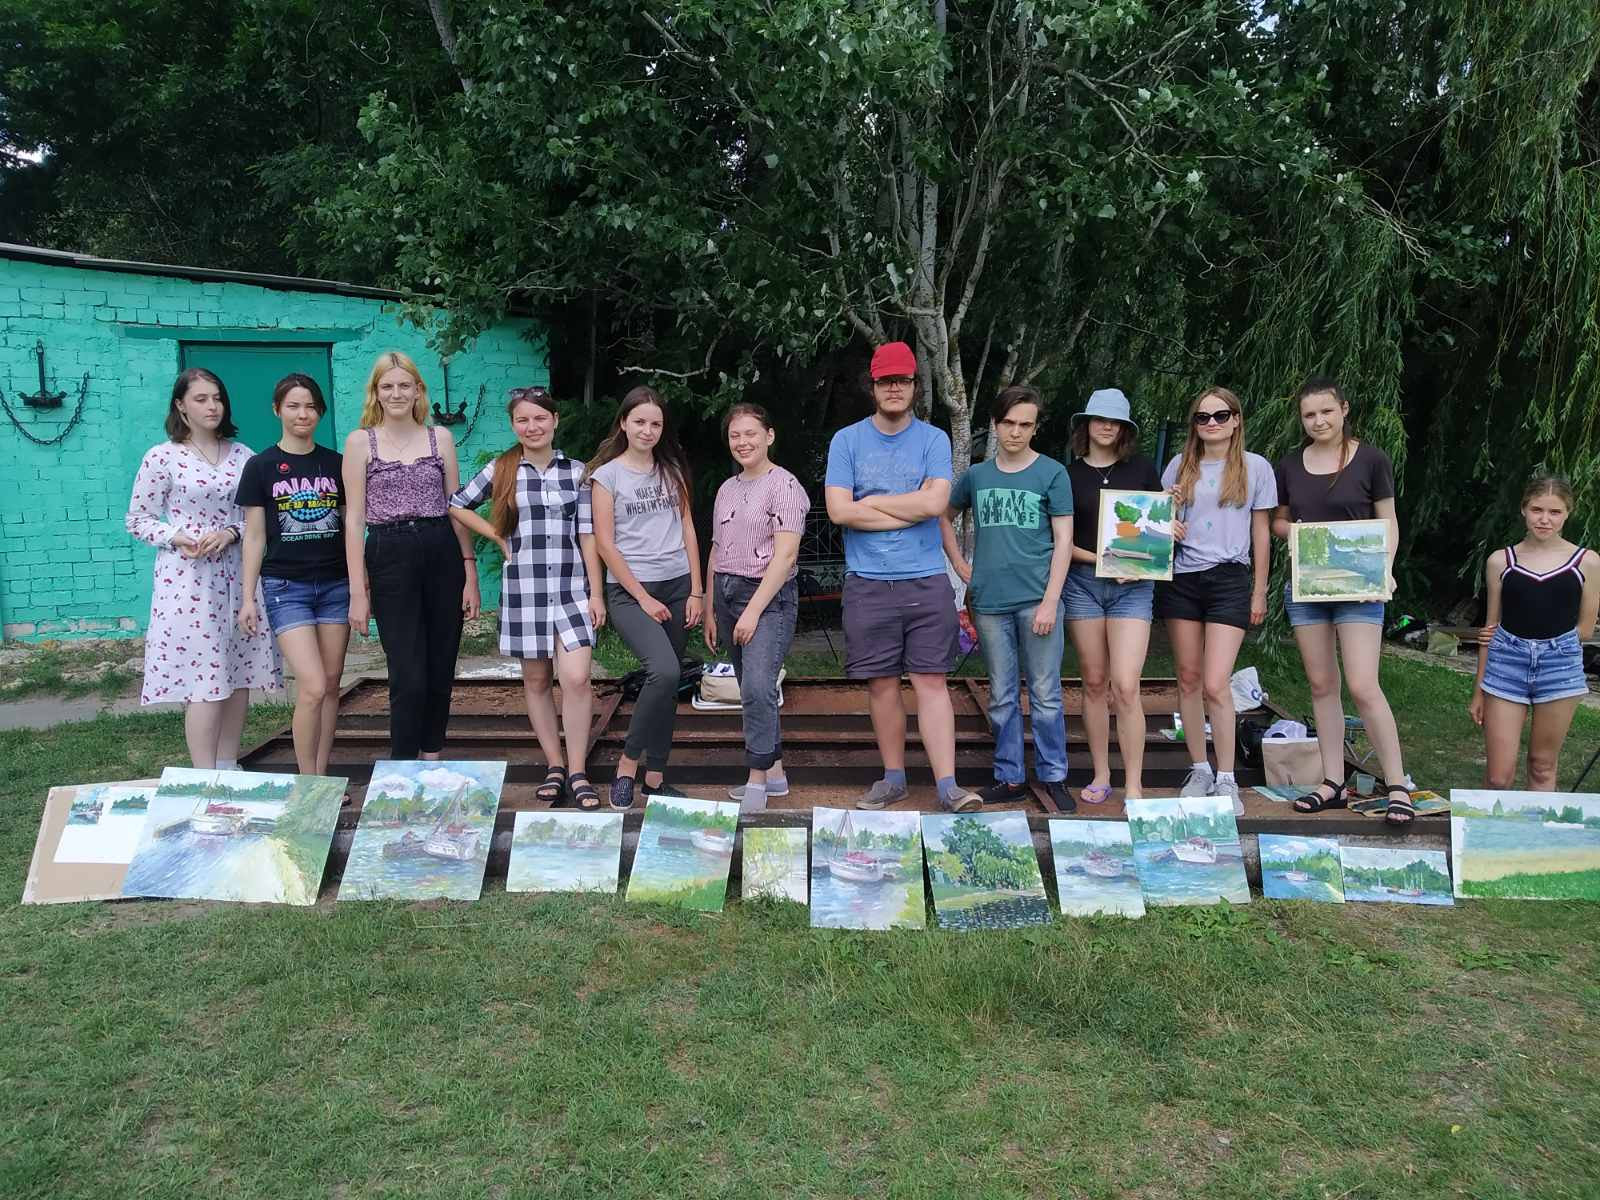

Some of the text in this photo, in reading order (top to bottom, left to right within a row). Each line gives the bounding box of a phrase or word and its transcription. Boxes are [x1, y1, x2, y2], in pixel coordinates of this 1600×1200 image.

[633, 485, 666, 500] WAKE ME
[278, 501, 304, 511] NEW
[625, 501, 647, 516] WHEN
[646, 499, 658, 512] I'M
